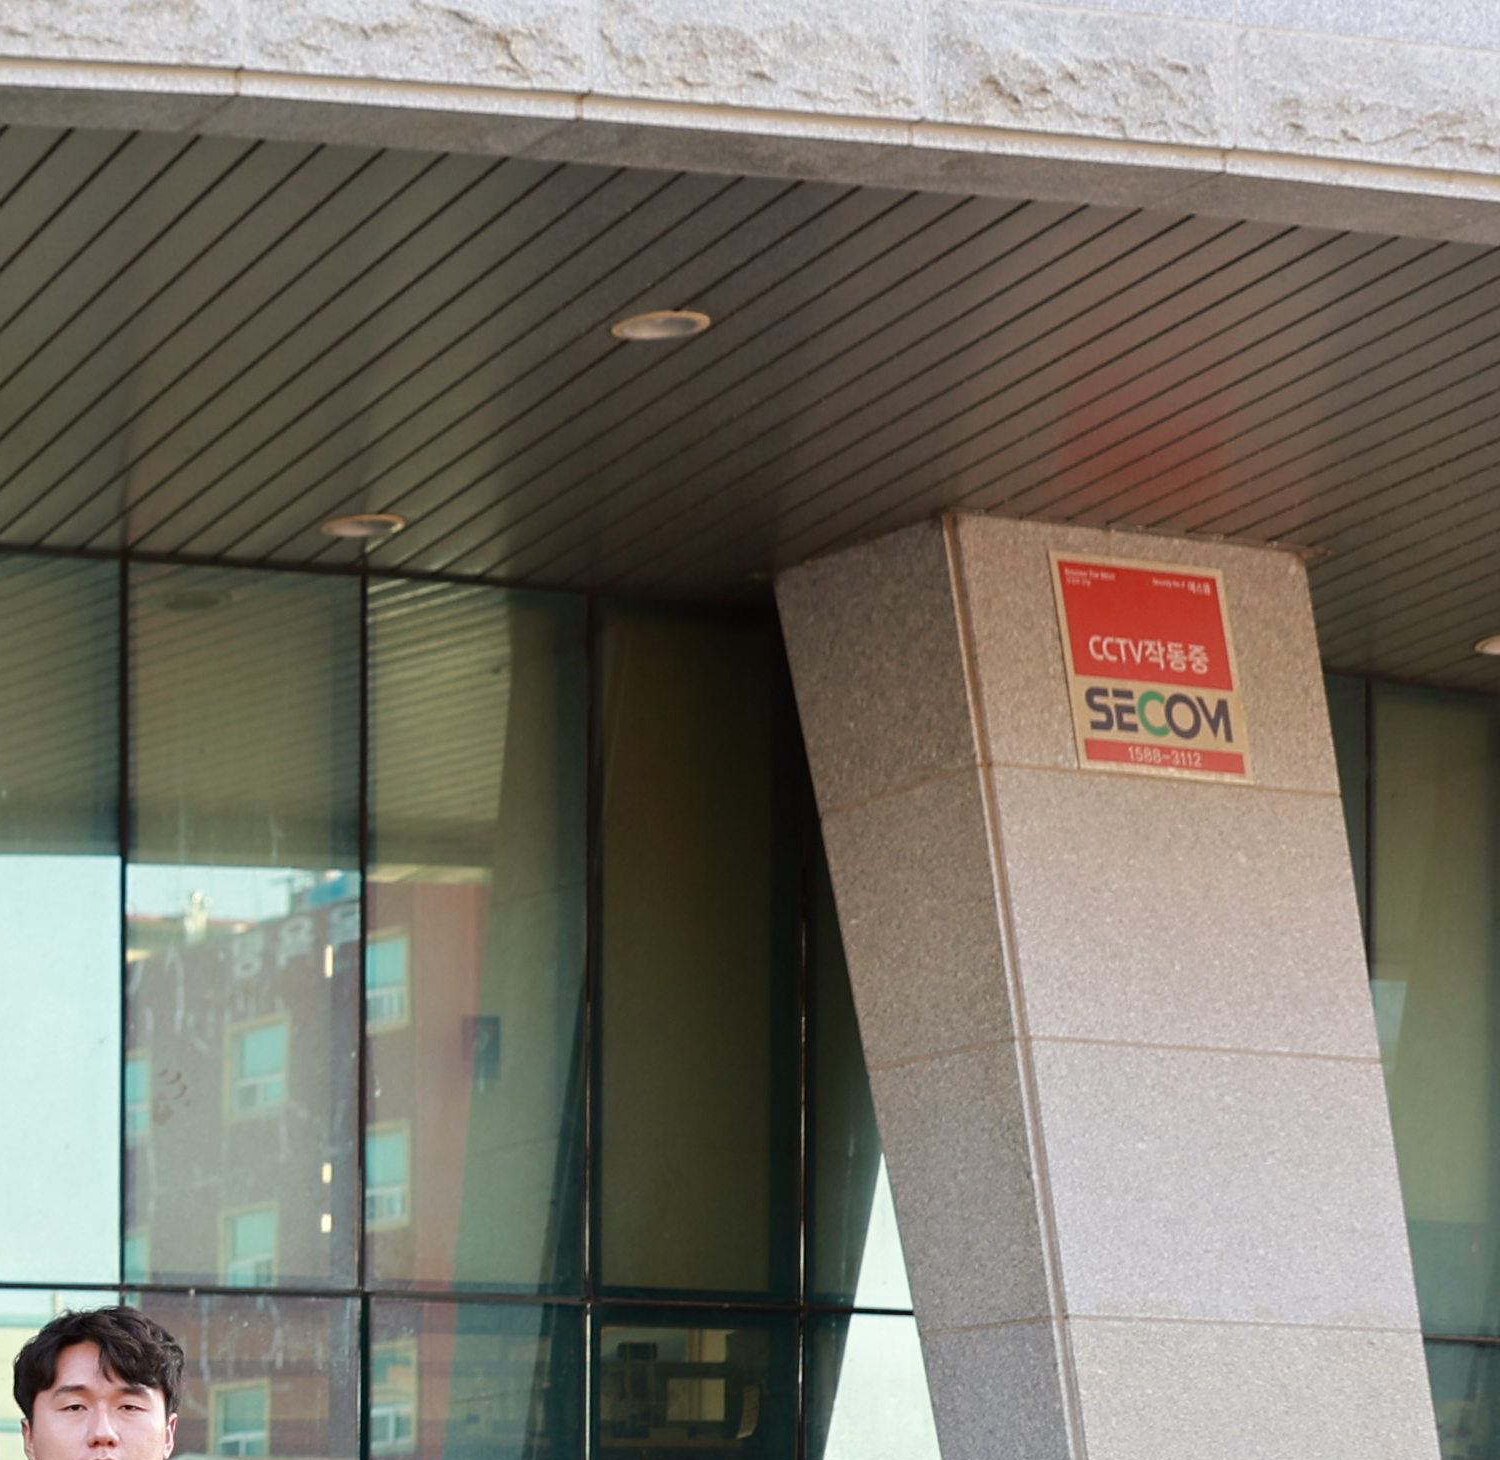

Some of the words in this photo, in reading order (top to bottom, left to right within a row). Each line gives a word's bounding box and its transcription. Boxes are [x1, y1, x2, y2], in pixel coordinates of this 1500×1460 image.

[1088, 634, 1210, 675] CCTV작동중
[1085, 687, 1233, 742] SECOM
[1128, 747, 1202, 767] 1588-3112
